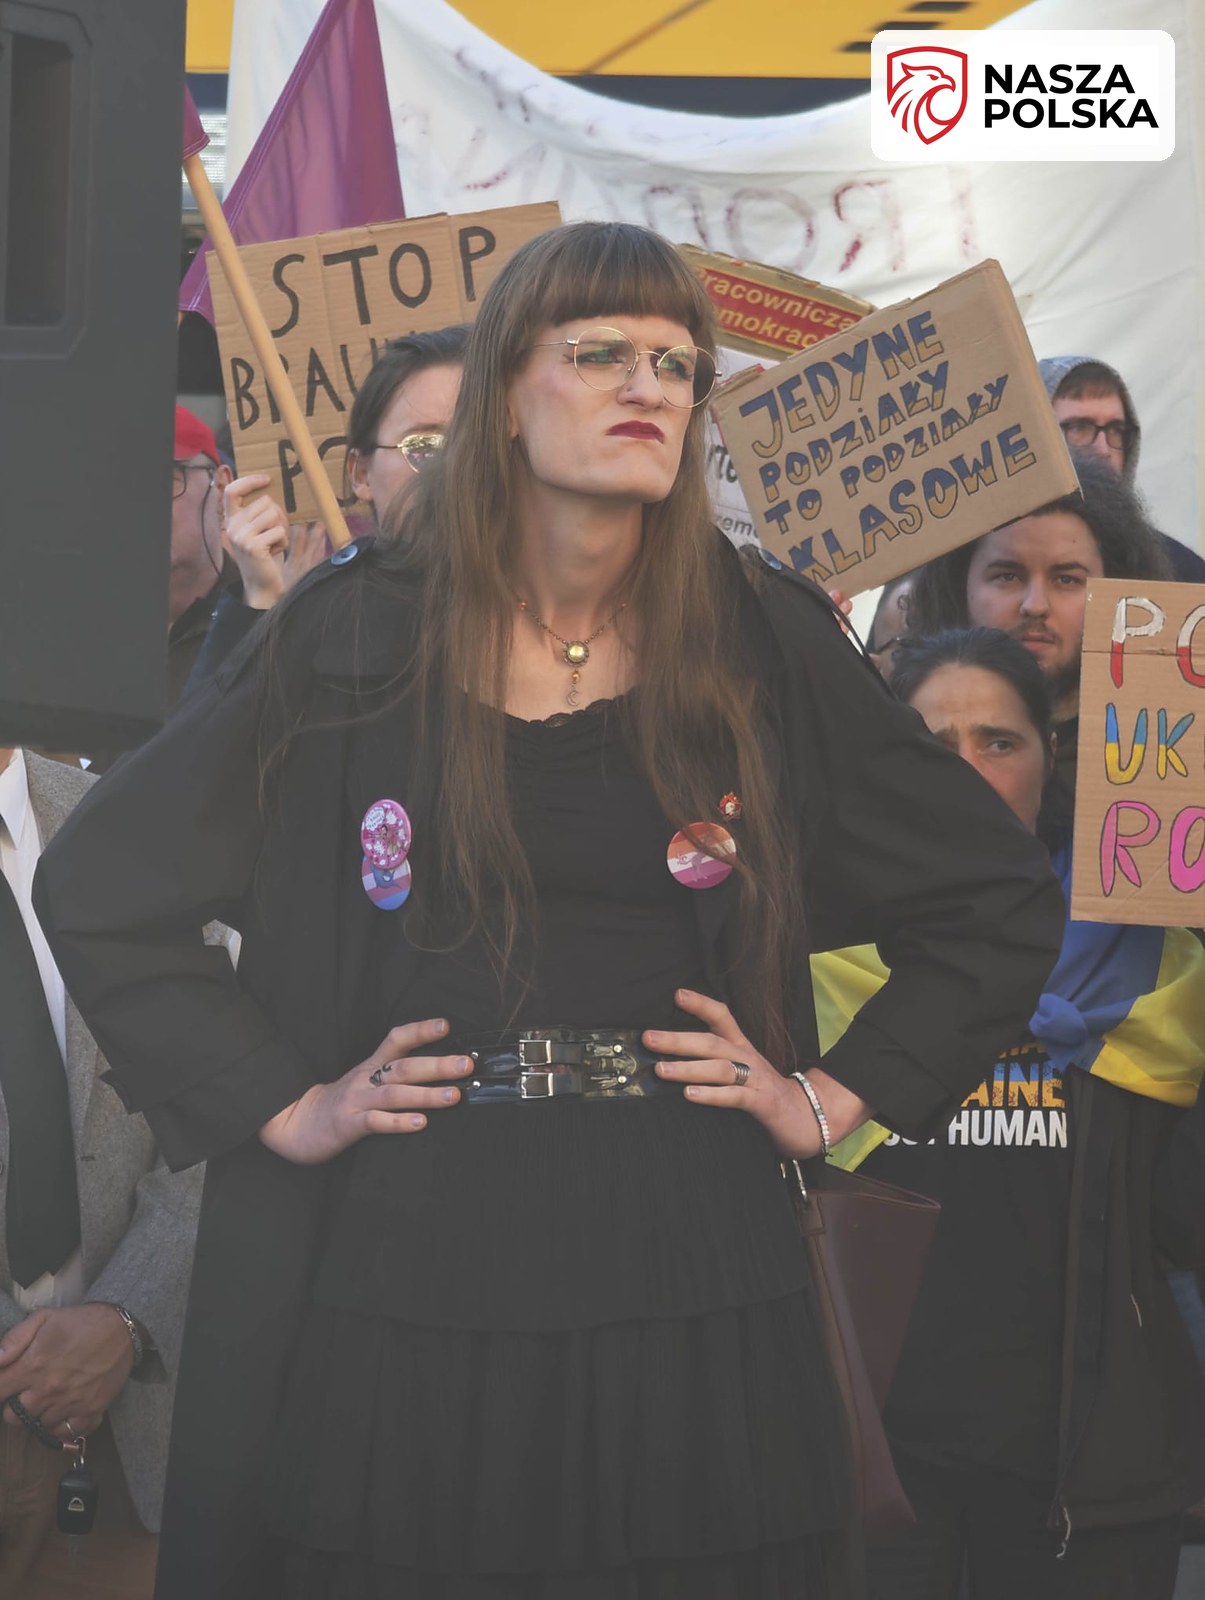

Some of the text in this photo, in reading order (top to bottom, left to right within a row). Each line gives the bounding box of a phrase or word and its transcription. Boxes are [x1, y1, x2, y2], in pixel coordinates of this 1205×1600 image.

[270, 225, 497, 338] STOP
[714, 304, 836, 350] mokrac
[738, 310, 945, 459] JEDYNE
[763, 488, 823, 535] TO
[839, 373, 1009, 498] PODZIAŁY
[787, 423, 1038, 587] KLASOWE
[1104, 702, 1205, 786] UK
[948, 1109, 1068, 1149] HUMAN
